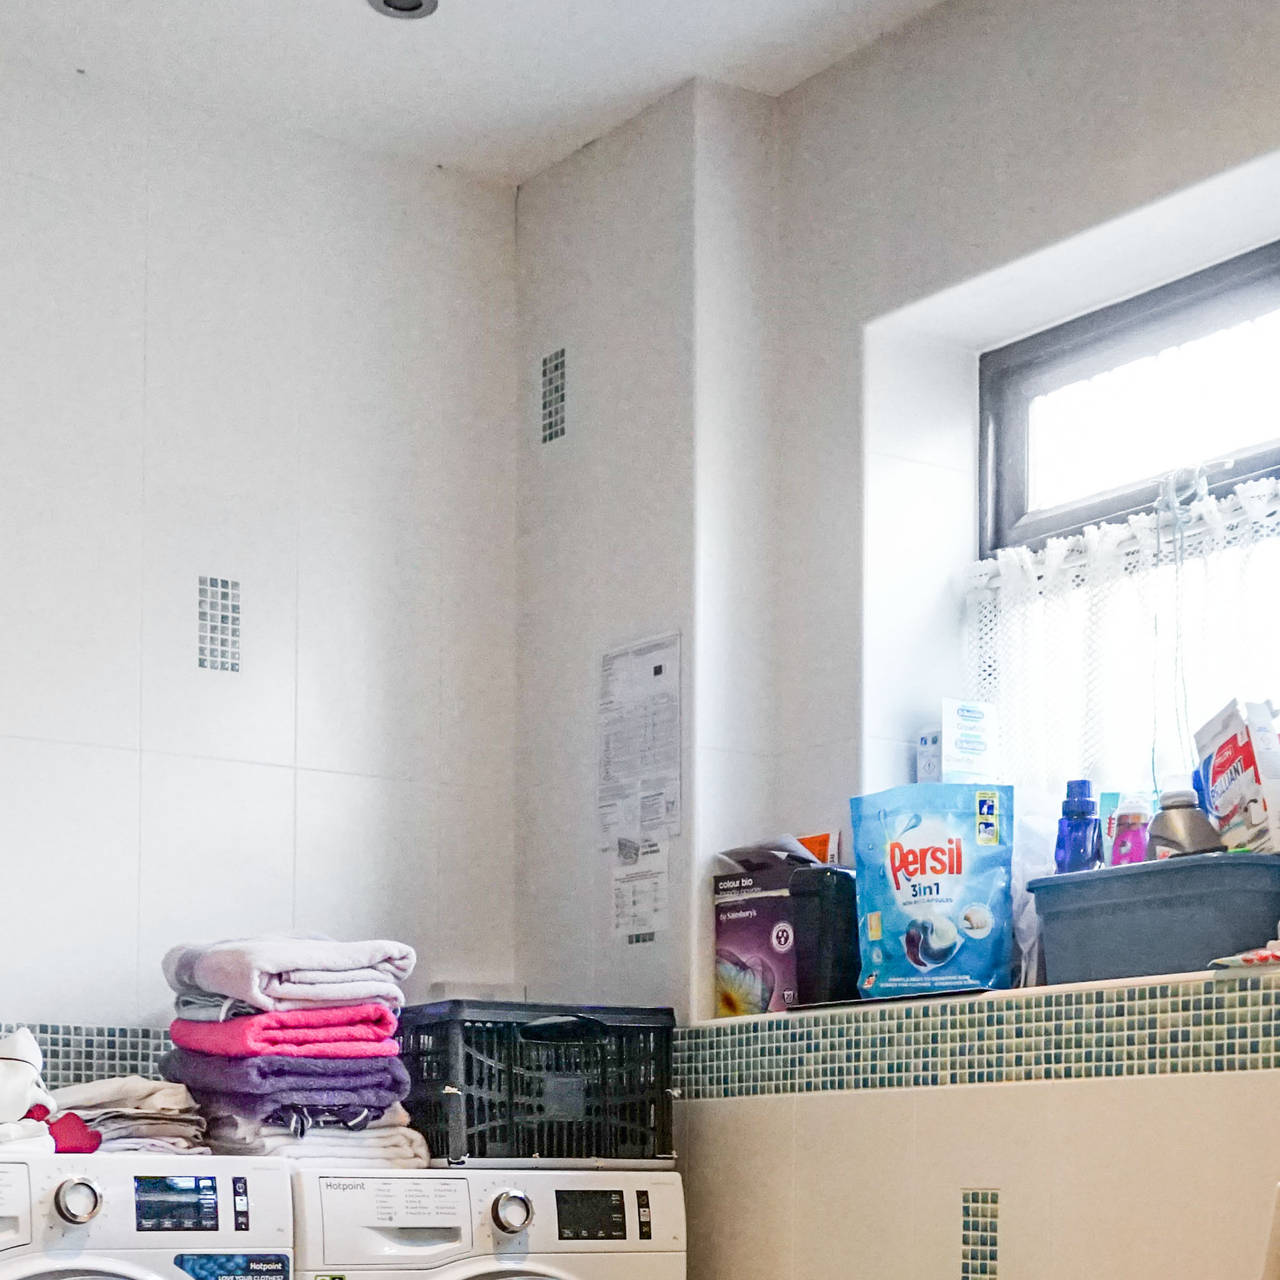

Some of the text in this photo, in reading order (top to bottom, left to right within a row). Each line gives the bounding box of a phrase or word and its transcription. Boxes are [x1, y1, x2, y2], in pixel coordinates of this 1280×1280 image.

[889, 838, 962, 890] Persil
[718, 877, 753, 889] colour bio
[325, 1182, 365, 1192] Hotpoint
[250, 1262, 282, 1271] Hotpoint
